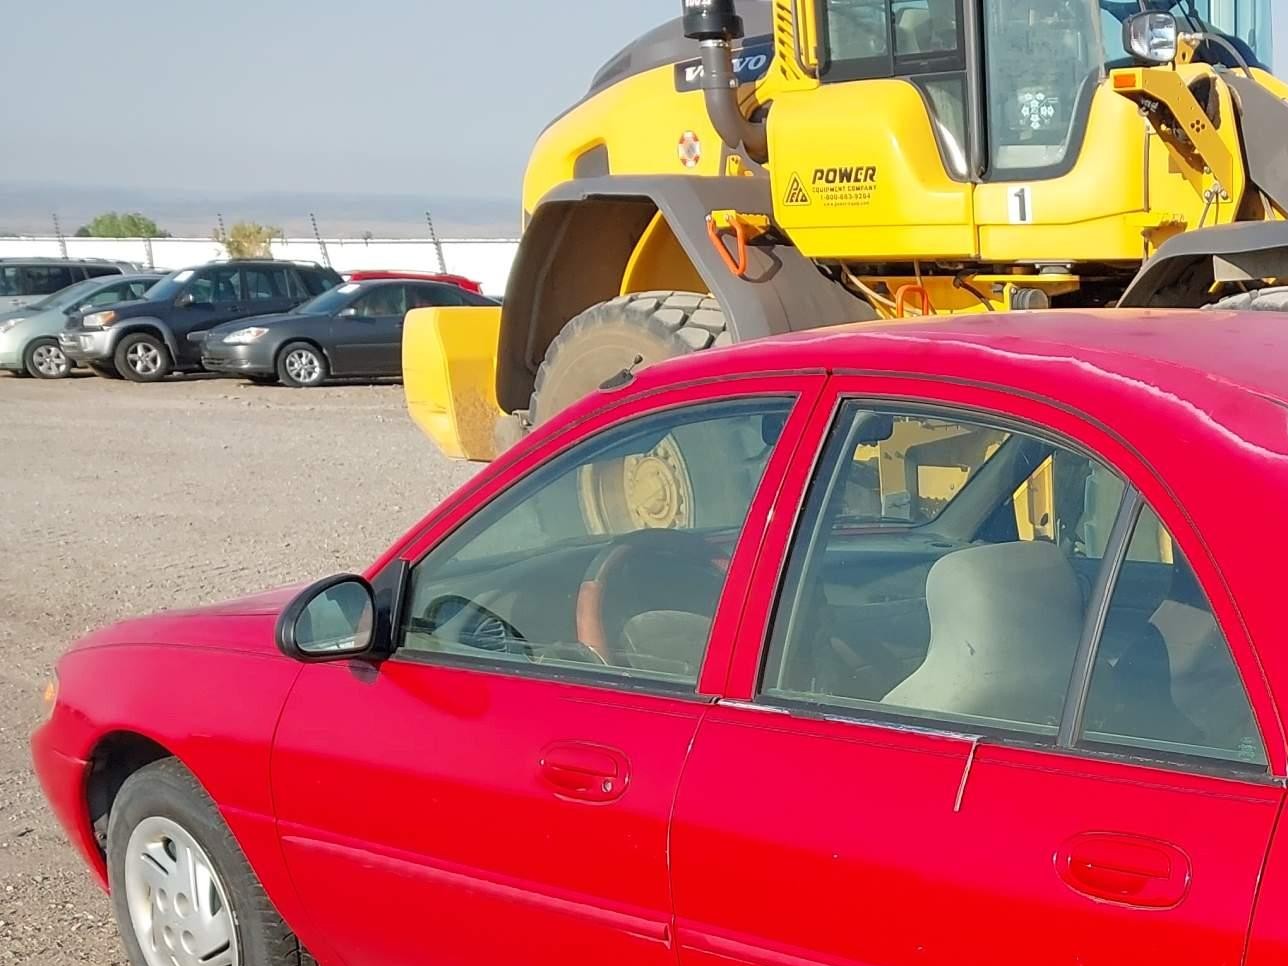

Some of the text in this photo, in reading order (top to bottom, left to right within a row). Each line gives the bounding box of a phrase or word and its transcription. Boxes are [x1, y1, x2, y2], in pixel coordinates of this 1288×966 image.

[684, 54, 767, 82] VVO
[811, 165, 877, 185] POWER
[811, 184, 877, 195] EQUIPMENT COMPANY
[1013, 187, 1027, 222] 1
